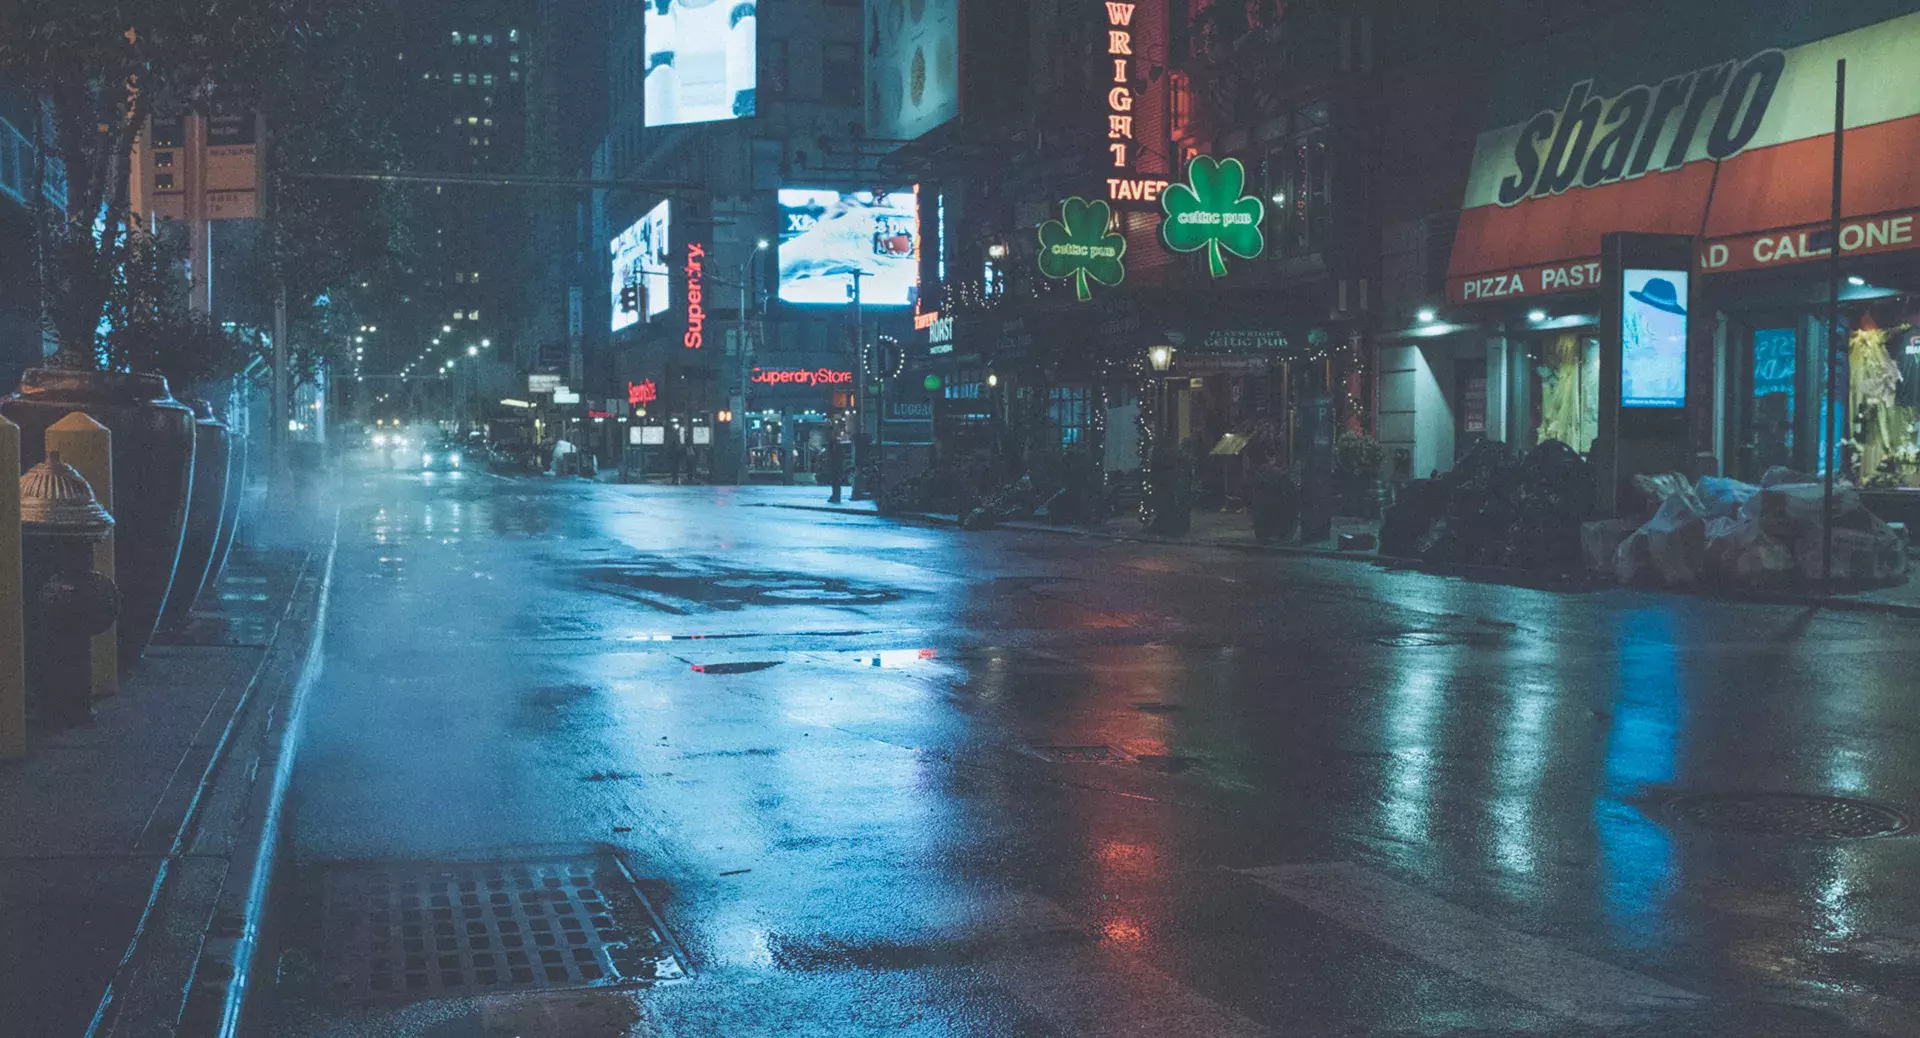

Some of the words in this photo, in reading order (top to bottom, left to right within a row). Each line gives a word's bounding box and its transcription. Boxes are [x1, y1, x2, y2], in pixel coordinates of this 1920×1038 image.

[1105, 1, 1135, 168] WRIGHT
[1495, 47, 1786, 208] sbarro
[1464, 273, 1525, 300] PIZZA
[1753, 216, 1913, 263] CALONE
[929, 316, 954, 343] ROAST
